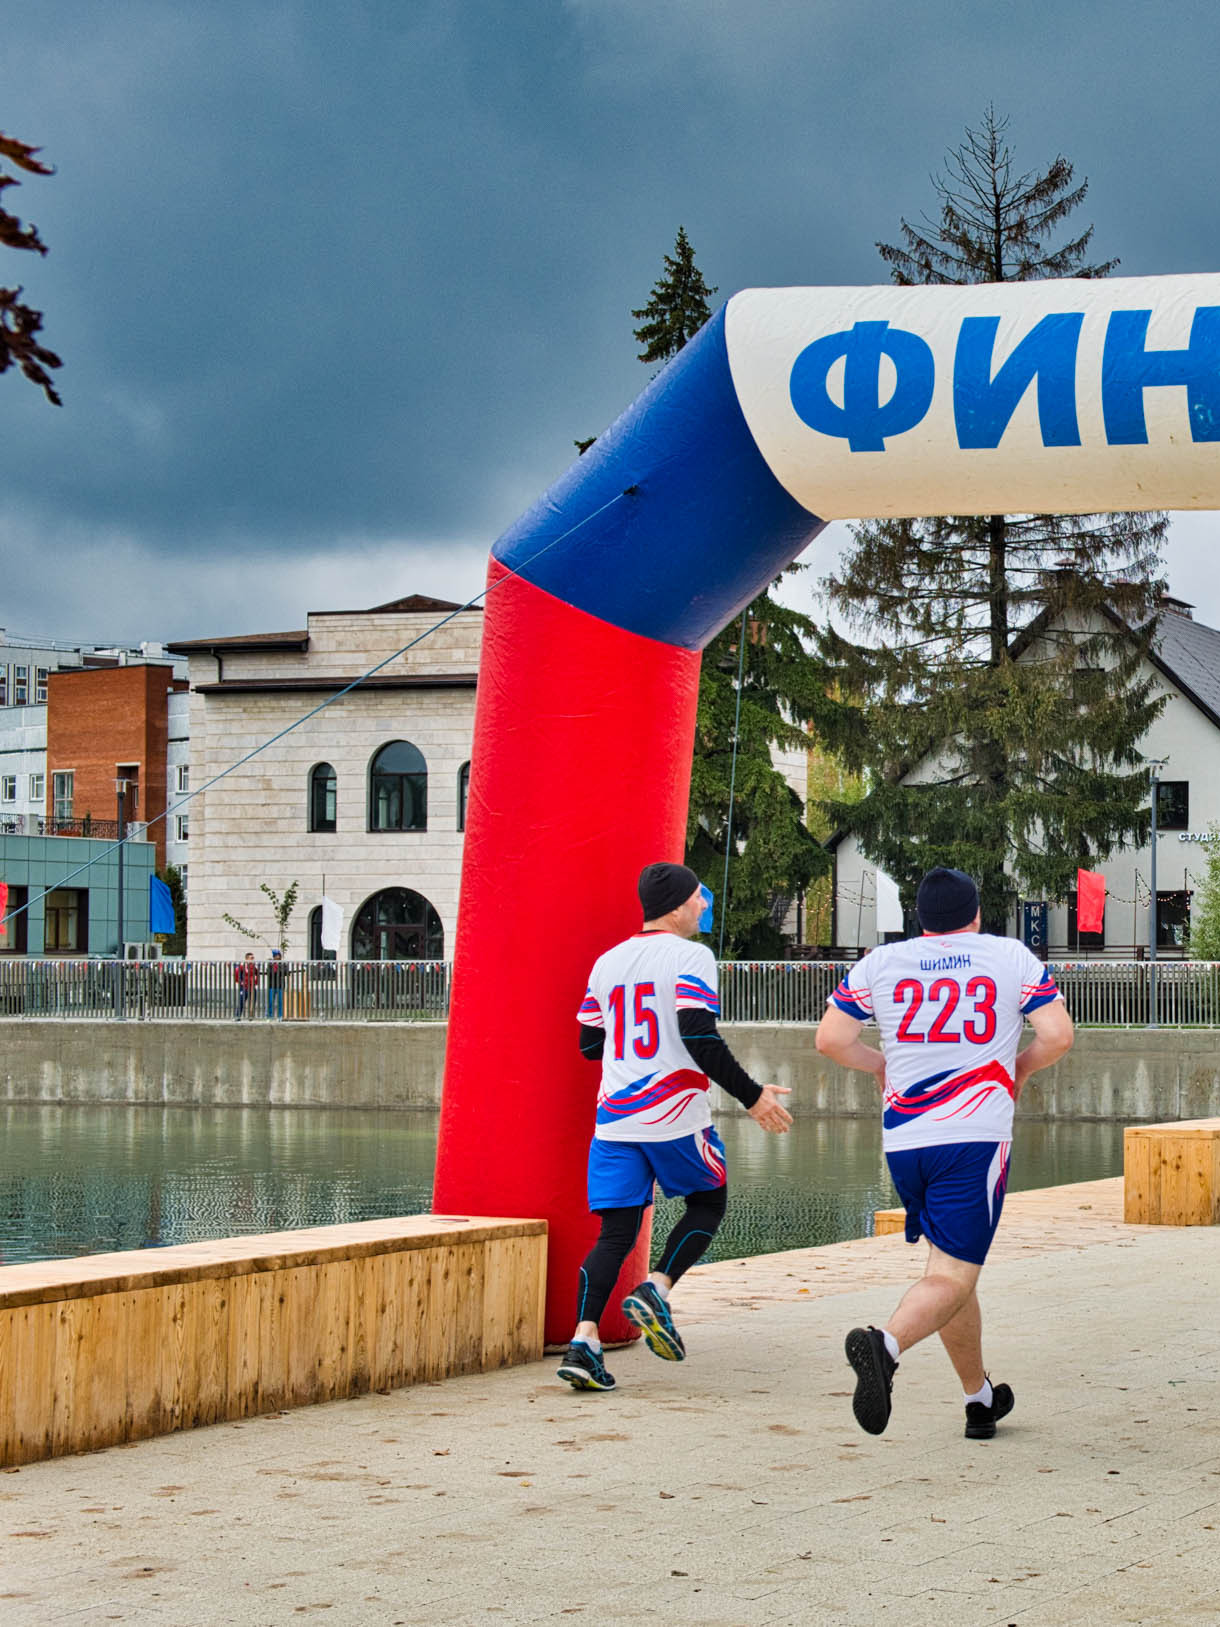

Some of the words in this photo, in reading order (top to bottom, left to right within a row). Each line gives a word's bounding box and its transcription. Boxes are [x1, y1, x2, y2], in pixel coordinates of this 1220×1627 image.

[920, 954, 971, 970] ШИМИН
[608, 981, 660, 1061] 15
[893, 975, 997, 1045] 223
